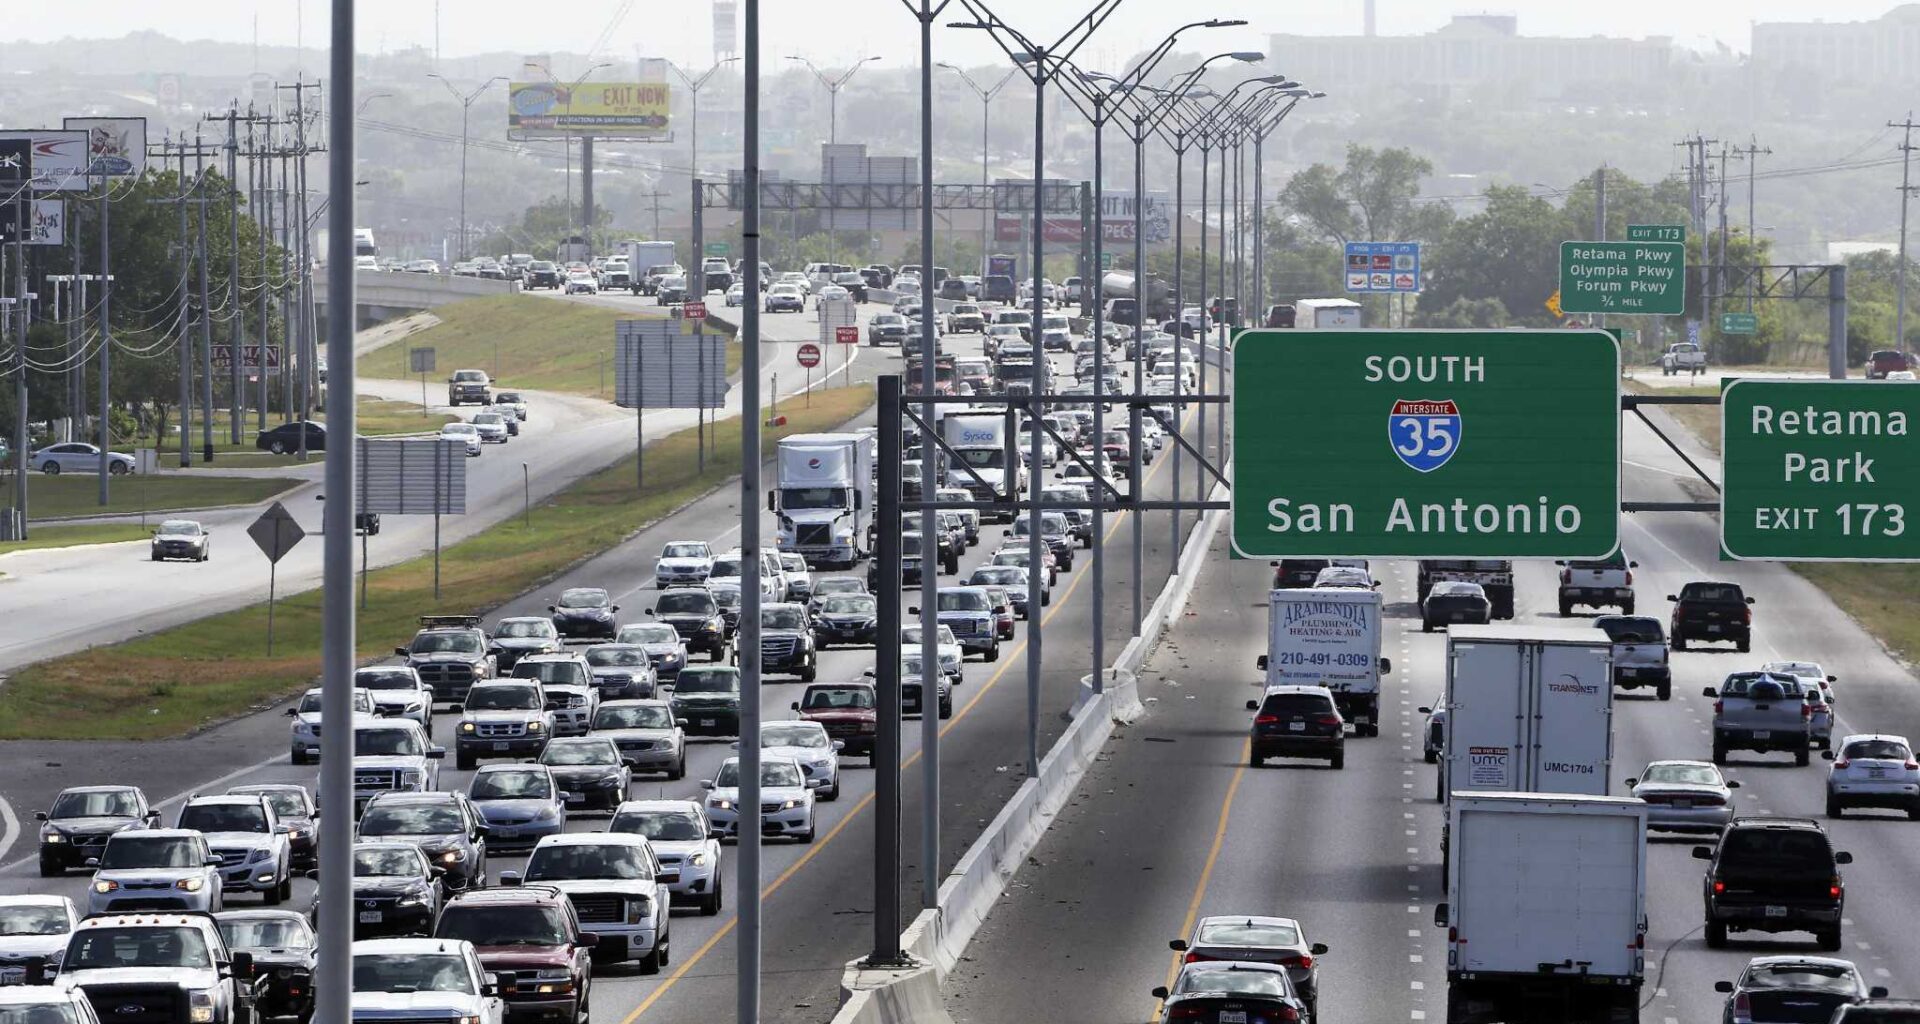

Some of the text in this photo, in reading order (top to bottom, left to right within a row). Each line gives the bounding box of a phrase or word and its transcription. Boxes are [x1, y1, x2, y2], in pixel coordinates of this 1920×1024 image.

[603, 87, 666, 106] EXIT NOW
[33, 167, 88, 176] OLLISION
[1097, 196, 1119, 215] XIT
[1103, 222, 1136, 239] PEC'S
[1633, 229, 1679, 239] EXIT 173
[1572, 248, 1672, 263] Retama Pkwy
[1570, 264, 1674, 279] Olympia Pkwy
[1577, 280, 1667, 294] Forum Pkwy
[1622, 298, 1643, 306] MILE
[1364, 355, 1486, 383] SOUTH
[1399, 404, 1451, 415] INTERSTATE
[1752, 404, 1908, 435] Retama
[963, 431, 994, 442] Sysco
[1398, 417, 1453, 457] 35
[1784, 451, 1876, 483] Park
[1267, 495, 1582, 533] San Antonio
[1755, 502, 1906, 536] EXIT 173
[1283, 601, 1367, 630] ARAMENDIA
[1301, 619, 1352, 628] PLUMBING
[1289, 627, 1361, 637] HEATING & AIR
[1281, 652, 1369, 667] 210-491-0309
[1472, 755, 1506, 765] umc
[1544, 762, 1594, 774] UMC1704
